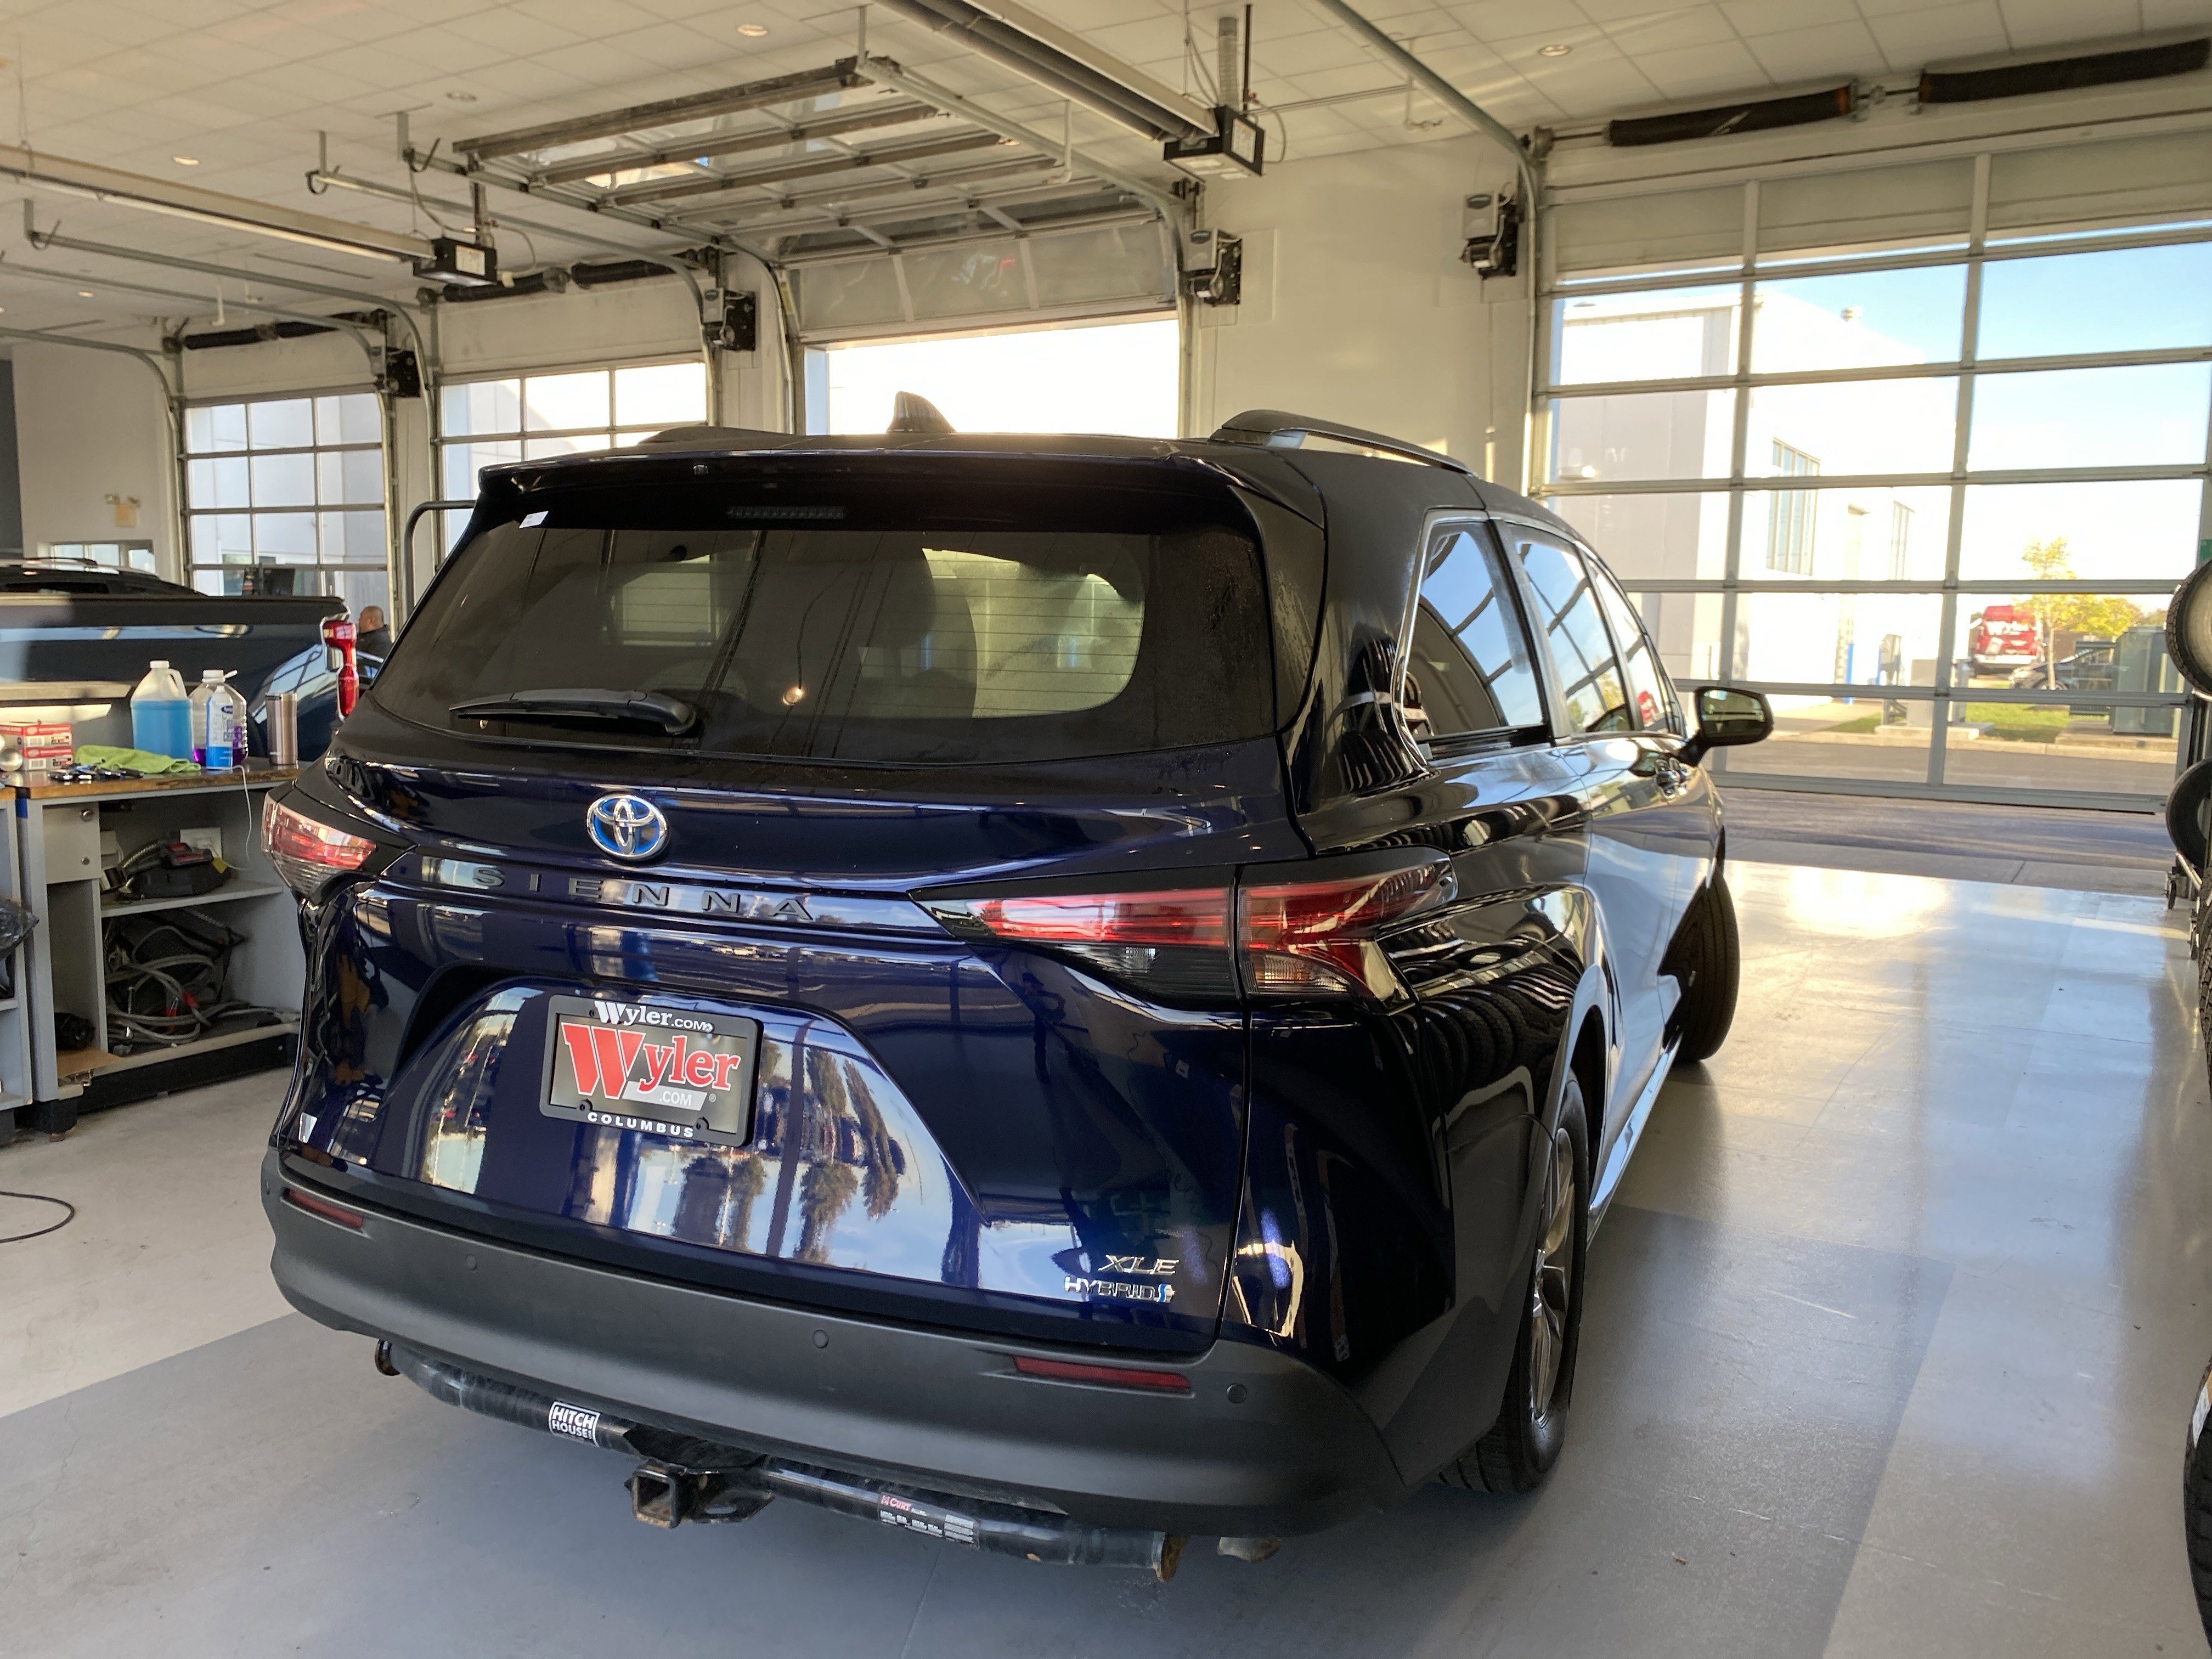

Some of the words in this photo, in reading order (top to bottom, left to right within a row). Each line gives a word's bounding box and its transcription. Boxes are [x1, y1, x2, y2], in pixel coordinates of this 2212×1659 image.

[471, 867, 815, 921] SIENNA
[561, 1022, 741, 1100] Wyler
[659, 1090, 692, 1107] .COM
[587, 1112, 694, 1138] COLUMBUS
[1098, 1254, 1180, 1276] XLE
[1064, 1276, 1155, 1300] HYBRID
[552, 1406, 595, 1430] HITCH
